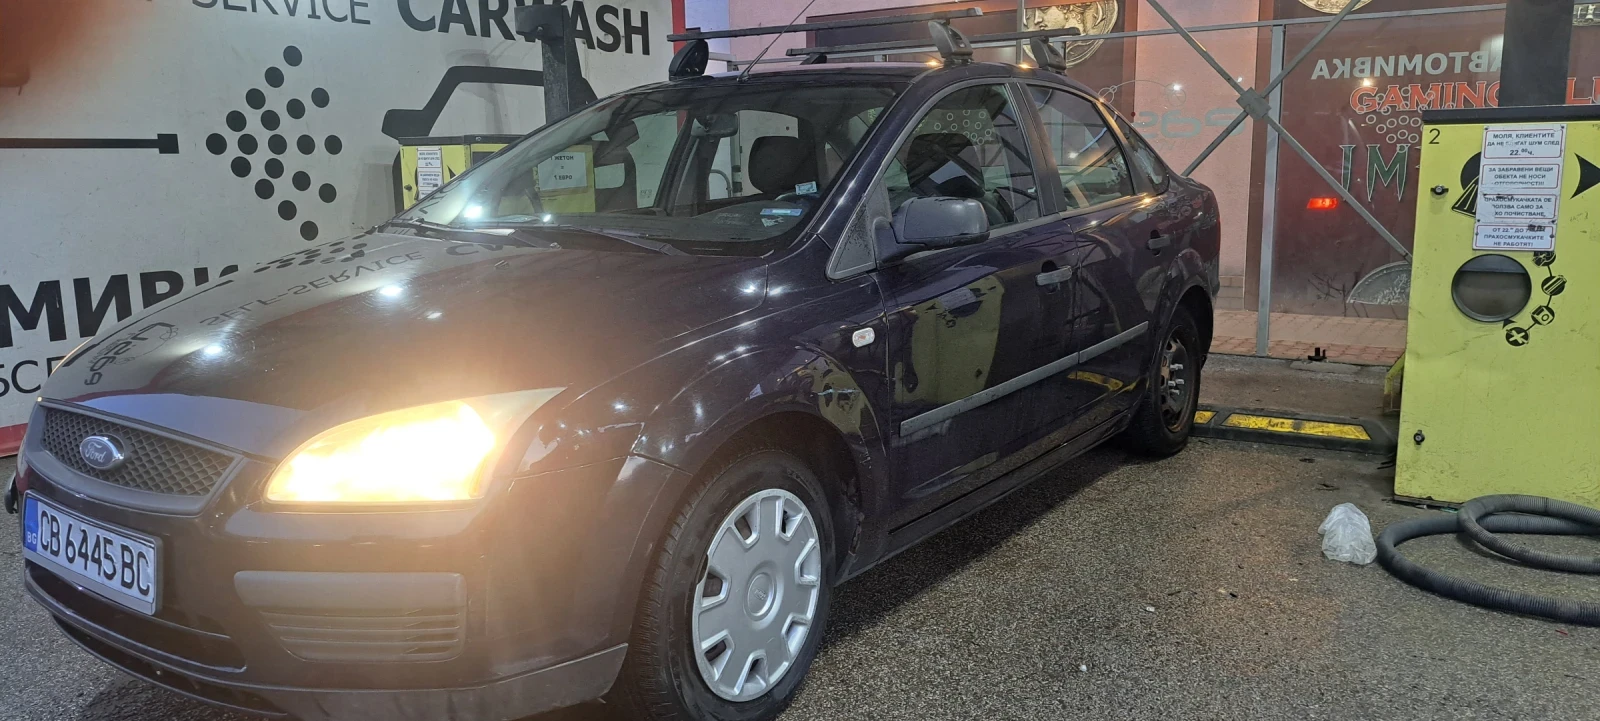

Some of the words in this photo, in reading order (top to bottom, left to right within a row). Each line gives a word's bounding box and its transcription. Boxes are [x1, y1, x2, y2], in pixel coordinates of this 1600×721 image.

[397, 0, 650, 56] CARASH
[1428, 128, 1440, 144] 2
[84, 442, 106, 463] Ford
[27, 532, 37, 544] BG
[65, 523, 117, 581] 6445
